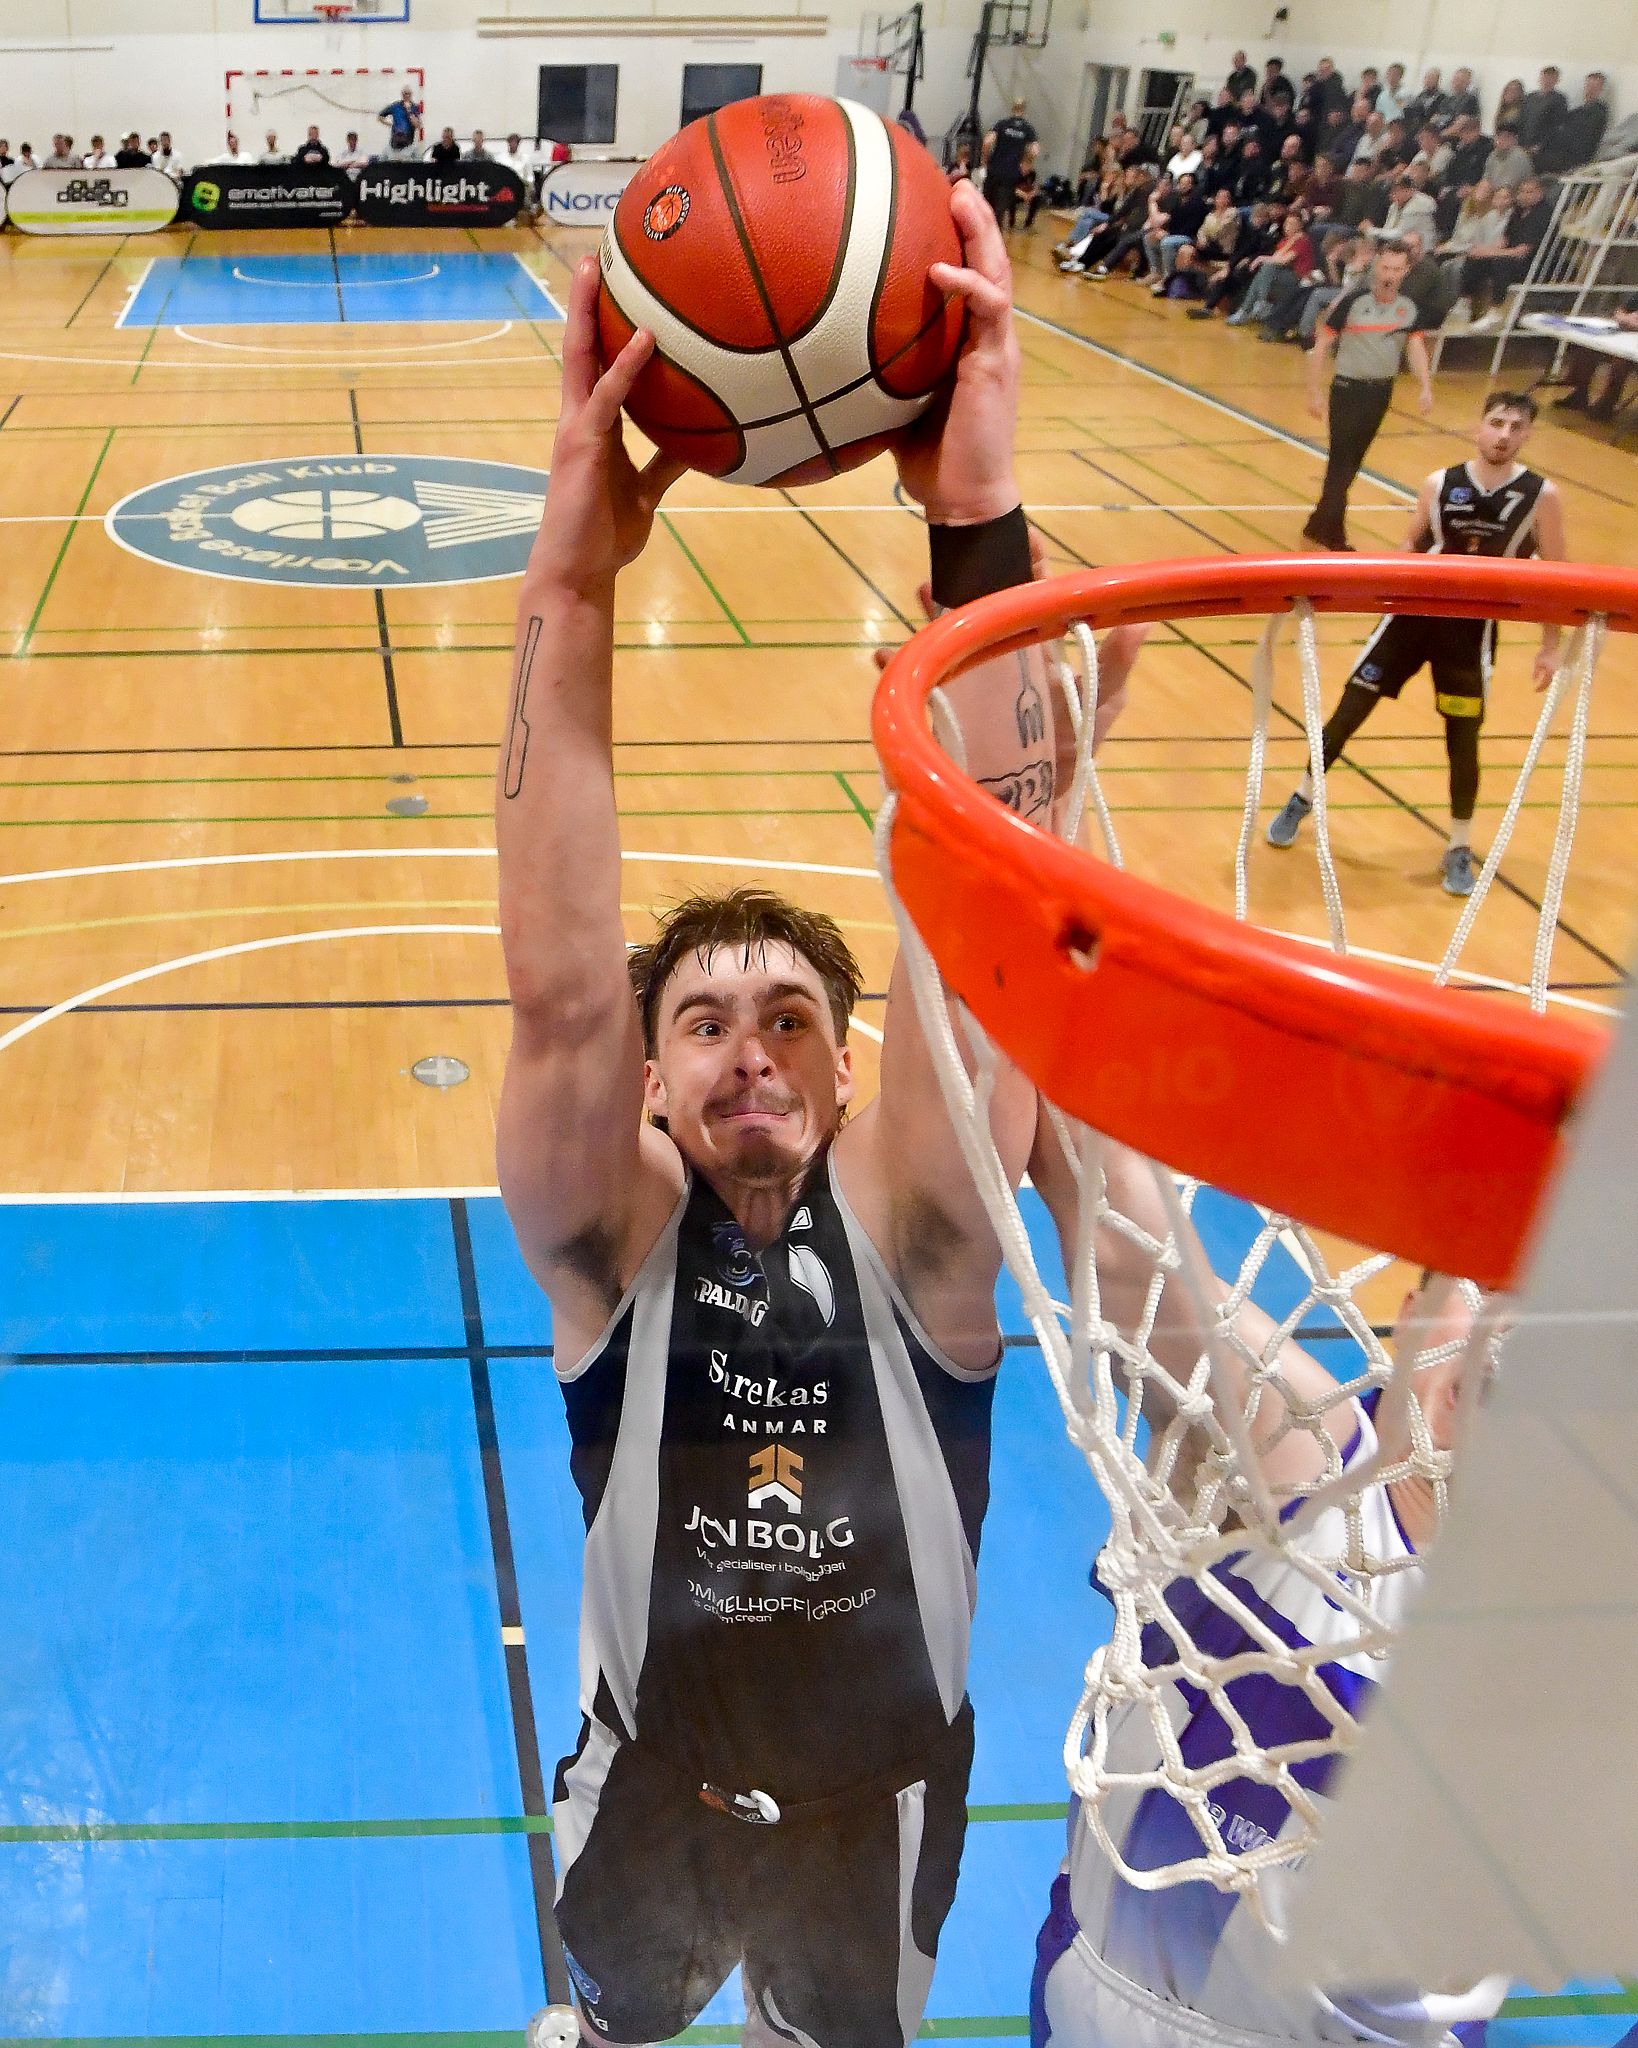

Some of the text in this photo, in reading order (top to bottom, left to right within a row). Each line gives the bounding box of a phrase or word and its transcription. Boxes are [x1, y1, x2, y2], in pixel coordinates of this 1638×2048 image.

[360, 178, 490, 204] Highlight
[286, 462, 398, 480] Klub
[1498, 490, 1525, 522] 7
